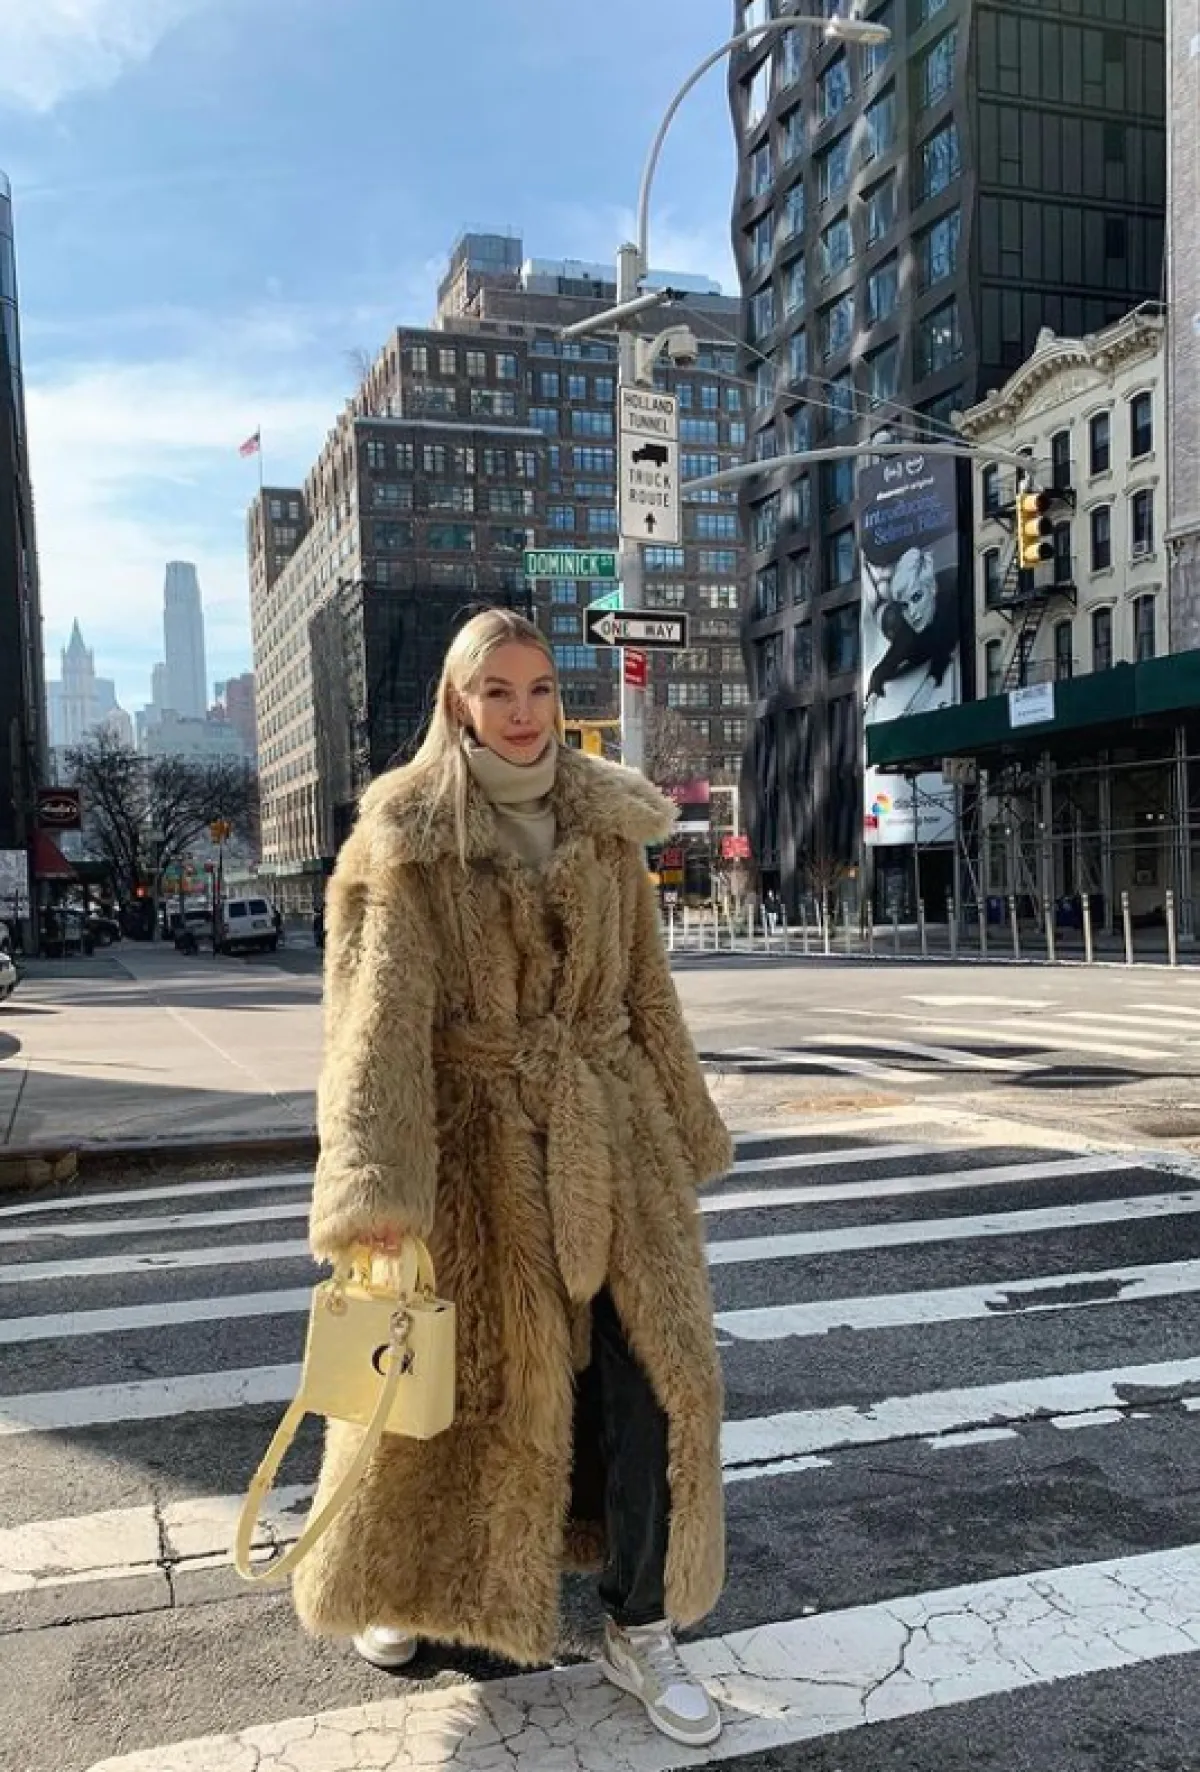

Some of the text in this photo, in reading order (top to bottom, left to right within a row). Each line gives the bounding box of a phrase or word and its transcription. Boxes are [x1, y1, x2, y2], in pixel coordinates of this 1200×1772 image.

[624, 392, 673, 414] HOLLAND
[628, 412, 669, 433] TUNNEL
[628, 469, 671, 489] TRUCK
[628, 488, 670, 508] ROUTE
[527, 553, 600, 575] DOMINICK
[601, 620, 674, 638] ONE WAY
